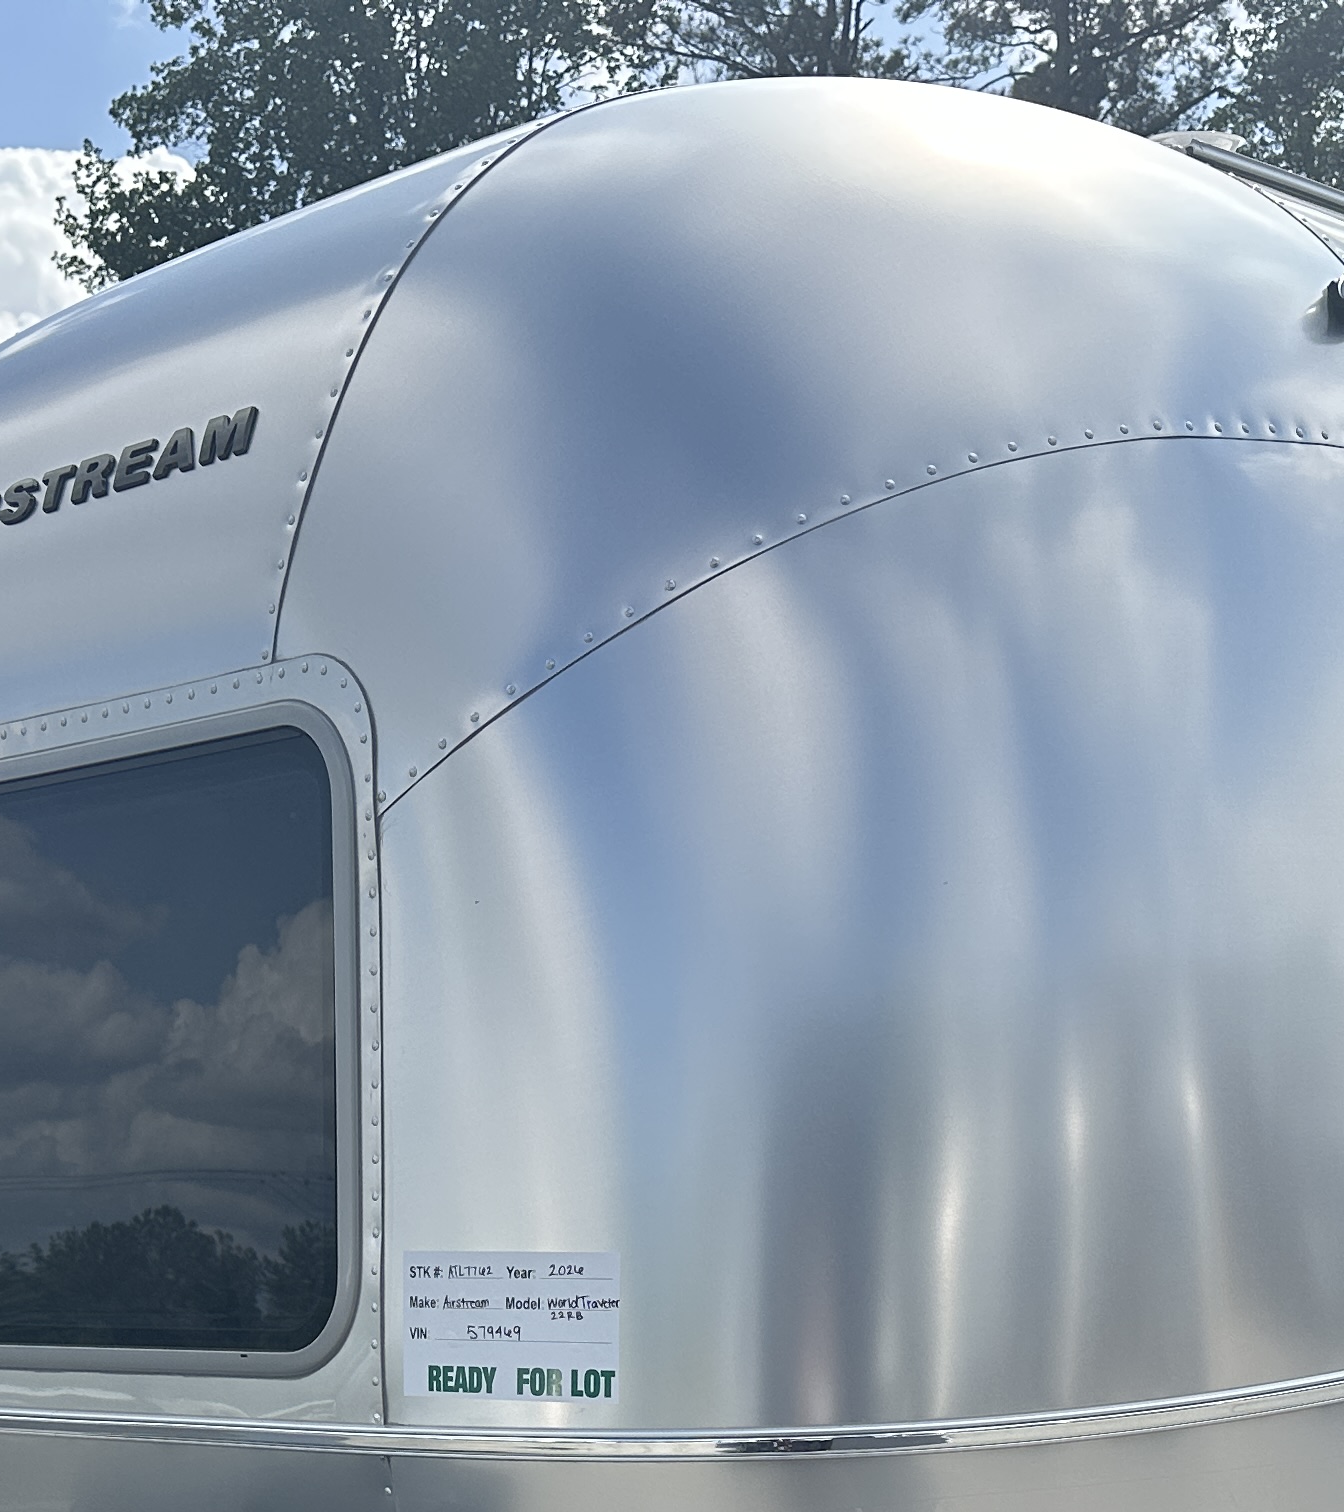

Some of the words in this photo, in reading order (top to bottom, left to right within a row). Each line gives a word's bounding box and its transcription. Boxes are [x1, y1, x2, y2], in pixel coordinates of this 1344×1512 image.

[409, 1265, 432, 1279] STK
[506, 1265, 537, 1280] Year:
[409, 1295, 440, 1309] Make:
[442, 1294, 490, 1310] Airstream
[505, 1296, 545, 1310] Model:
[409, 1326, 431, 1340] VIN:
[427, 1364, 498, 1394] READY
[516, 1367, 563, 1397] FOR
[569, 1368, 616, 1399] LOT
